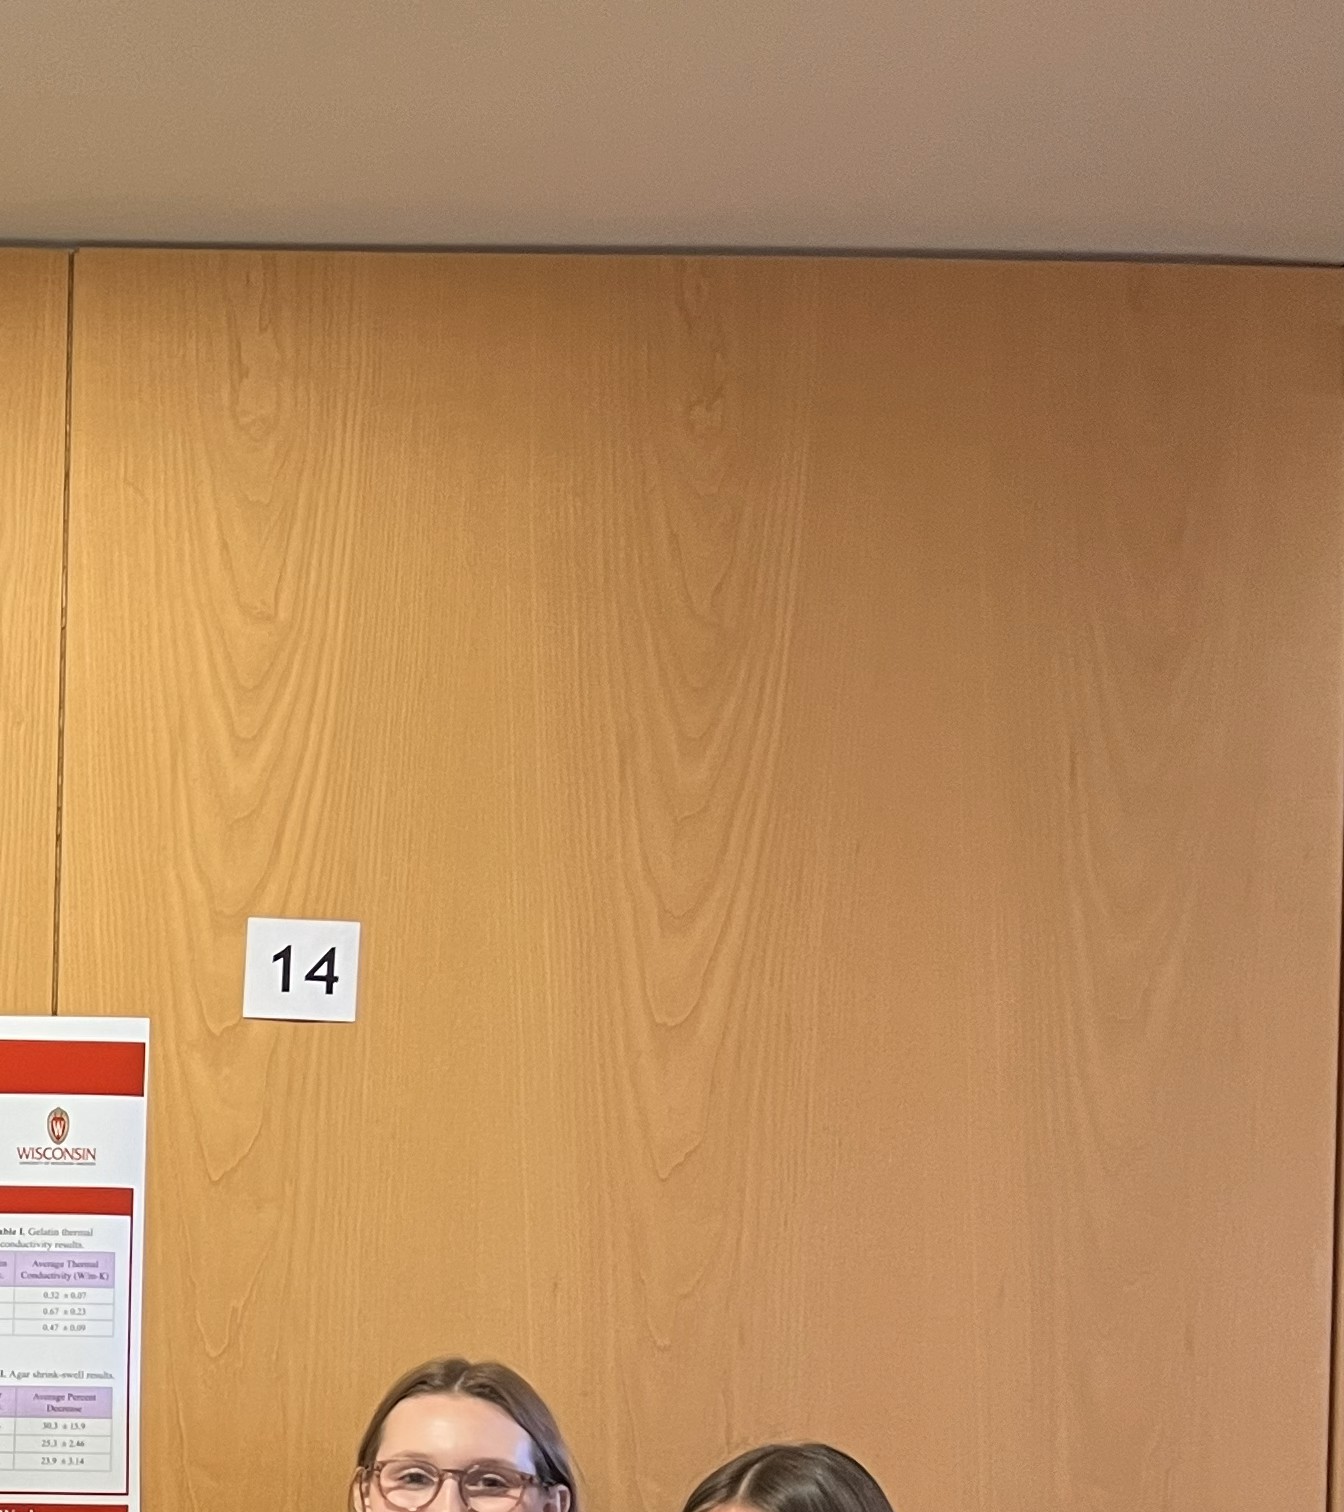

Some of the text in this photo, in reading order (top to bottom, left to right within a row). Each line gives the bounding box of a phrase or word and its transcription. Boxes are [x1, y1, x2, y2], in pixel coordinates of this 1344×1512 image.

[272, 945, 339, 994] 14
[17, 1146, 97, 1161] WISCONSIN
[27, 1226, 60, 1237] Gelatin
[61, 1227, 94, 1237] thermal
